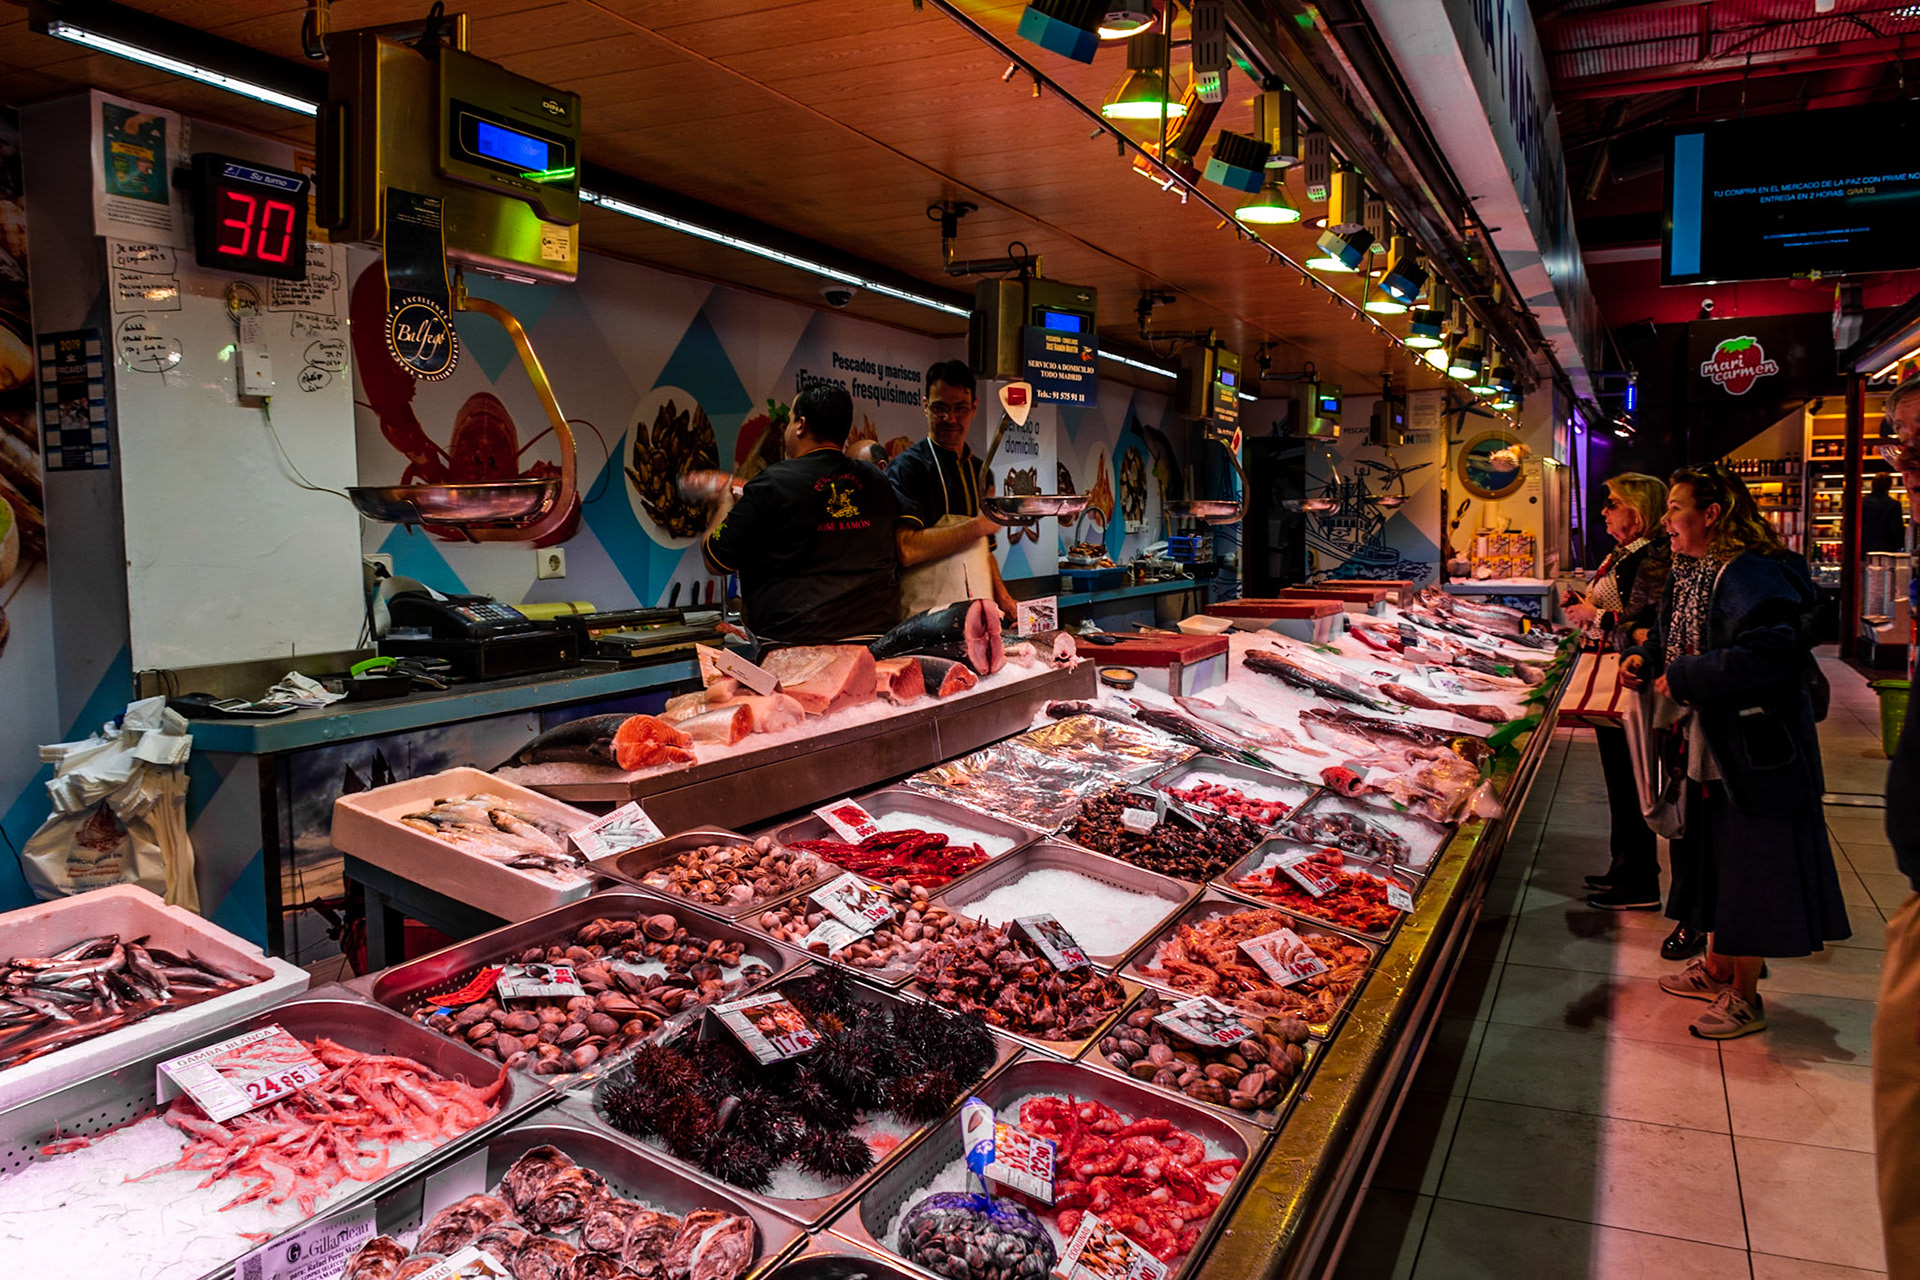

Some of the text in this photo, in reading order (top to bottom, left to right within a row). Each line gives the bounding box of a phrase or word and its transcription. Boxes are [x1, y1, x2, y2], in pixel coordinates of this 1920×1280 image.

[542, 100, 565, 114] DINA
[250, 172, 287, 187] Su turno
[1724, 188, 1757, 196] COMPRA
[1781, 181, 1820, 191] MERCADO
[1882, 173, 1907, 182] PRIME
[1760, 194, 1795, 203] ENTREGA
[1846, 186, 1876, 196] GRATIS
[218, 191, 296, 263] 30
[402, 296, 448, 320] EXCELLENCE
[426, 332, 460, 382] SUSTAINABILITY
[1704, 354, 1744, 374] mari
[832, 352, 921, 383] Pescados y mariscos
[1027, 360, 1057, 369] SERVICIO
[1062, 364, 1095, 374] DOMICILIO
[1040, 370, 1082, 381] TODO MADRID
[1714, 363, 1774, 381] carmen
[852, 377, 922, 408] fresquísimos!
[1060, 392, 1071, 400] 575
[1005, 436, 1039, 455] domicilio
[840, 520, 871, 530] RAMÓN
[863, 909, 880, 922] 19
[177, 1030, 273, 1067] GAMBA BLANCA
[776, 1035, 798, 1053] 17
[246, 1077, 282, 1100] 24
[309, 1223, 370, 1256] Gillardeau
[1068, 1226, 1091, 1260] COQUINAS
[307, 1258, 327, 1272] Rafael
